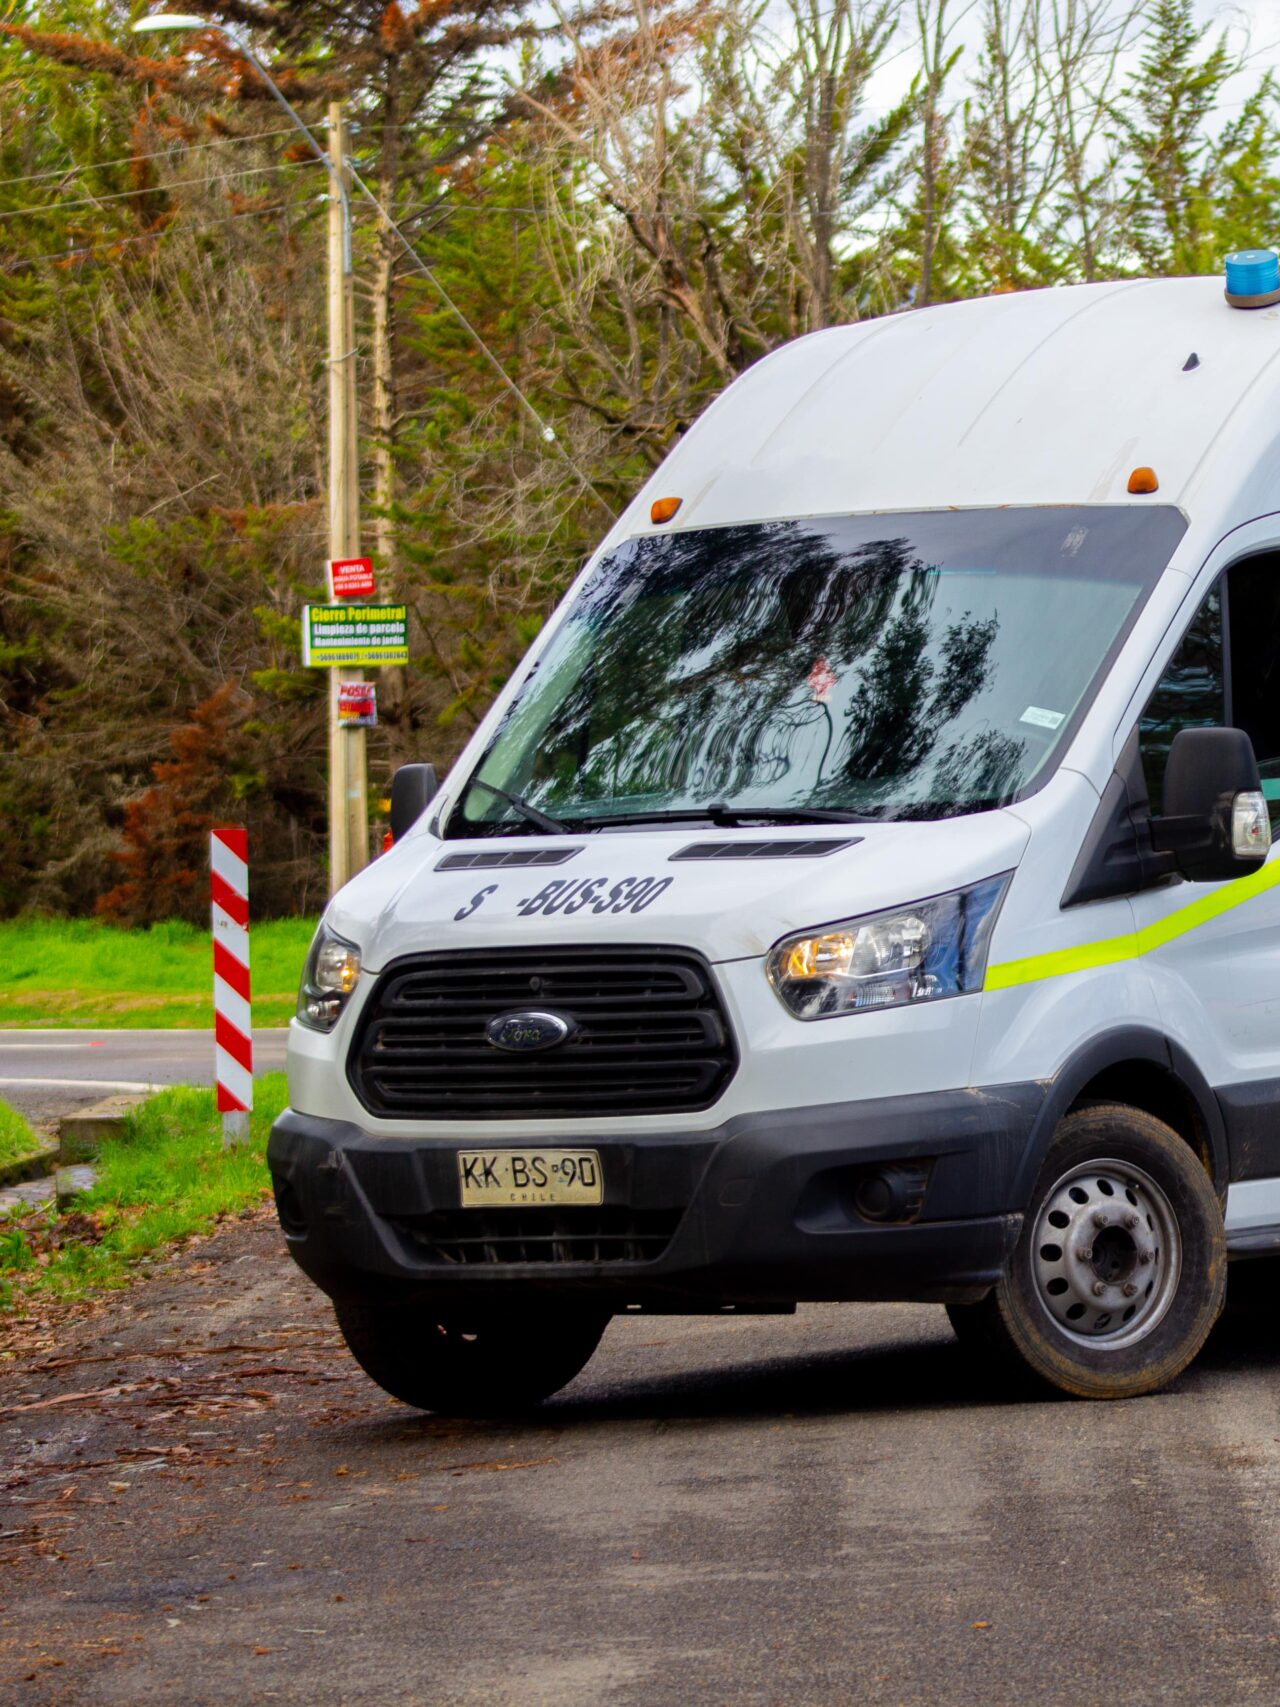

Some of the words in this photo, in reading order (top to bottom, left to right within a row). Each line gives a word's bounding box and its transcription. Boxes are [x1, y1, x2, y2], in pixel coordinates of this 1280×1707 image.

[339, 564, 365, 574] VENTA
[311, 607, 346, 622] Cierre
[347, 605, 406, 621] Perimetral
[355, 622, 368, 634] de
[510, 1193, 558, 1201] CHILE
